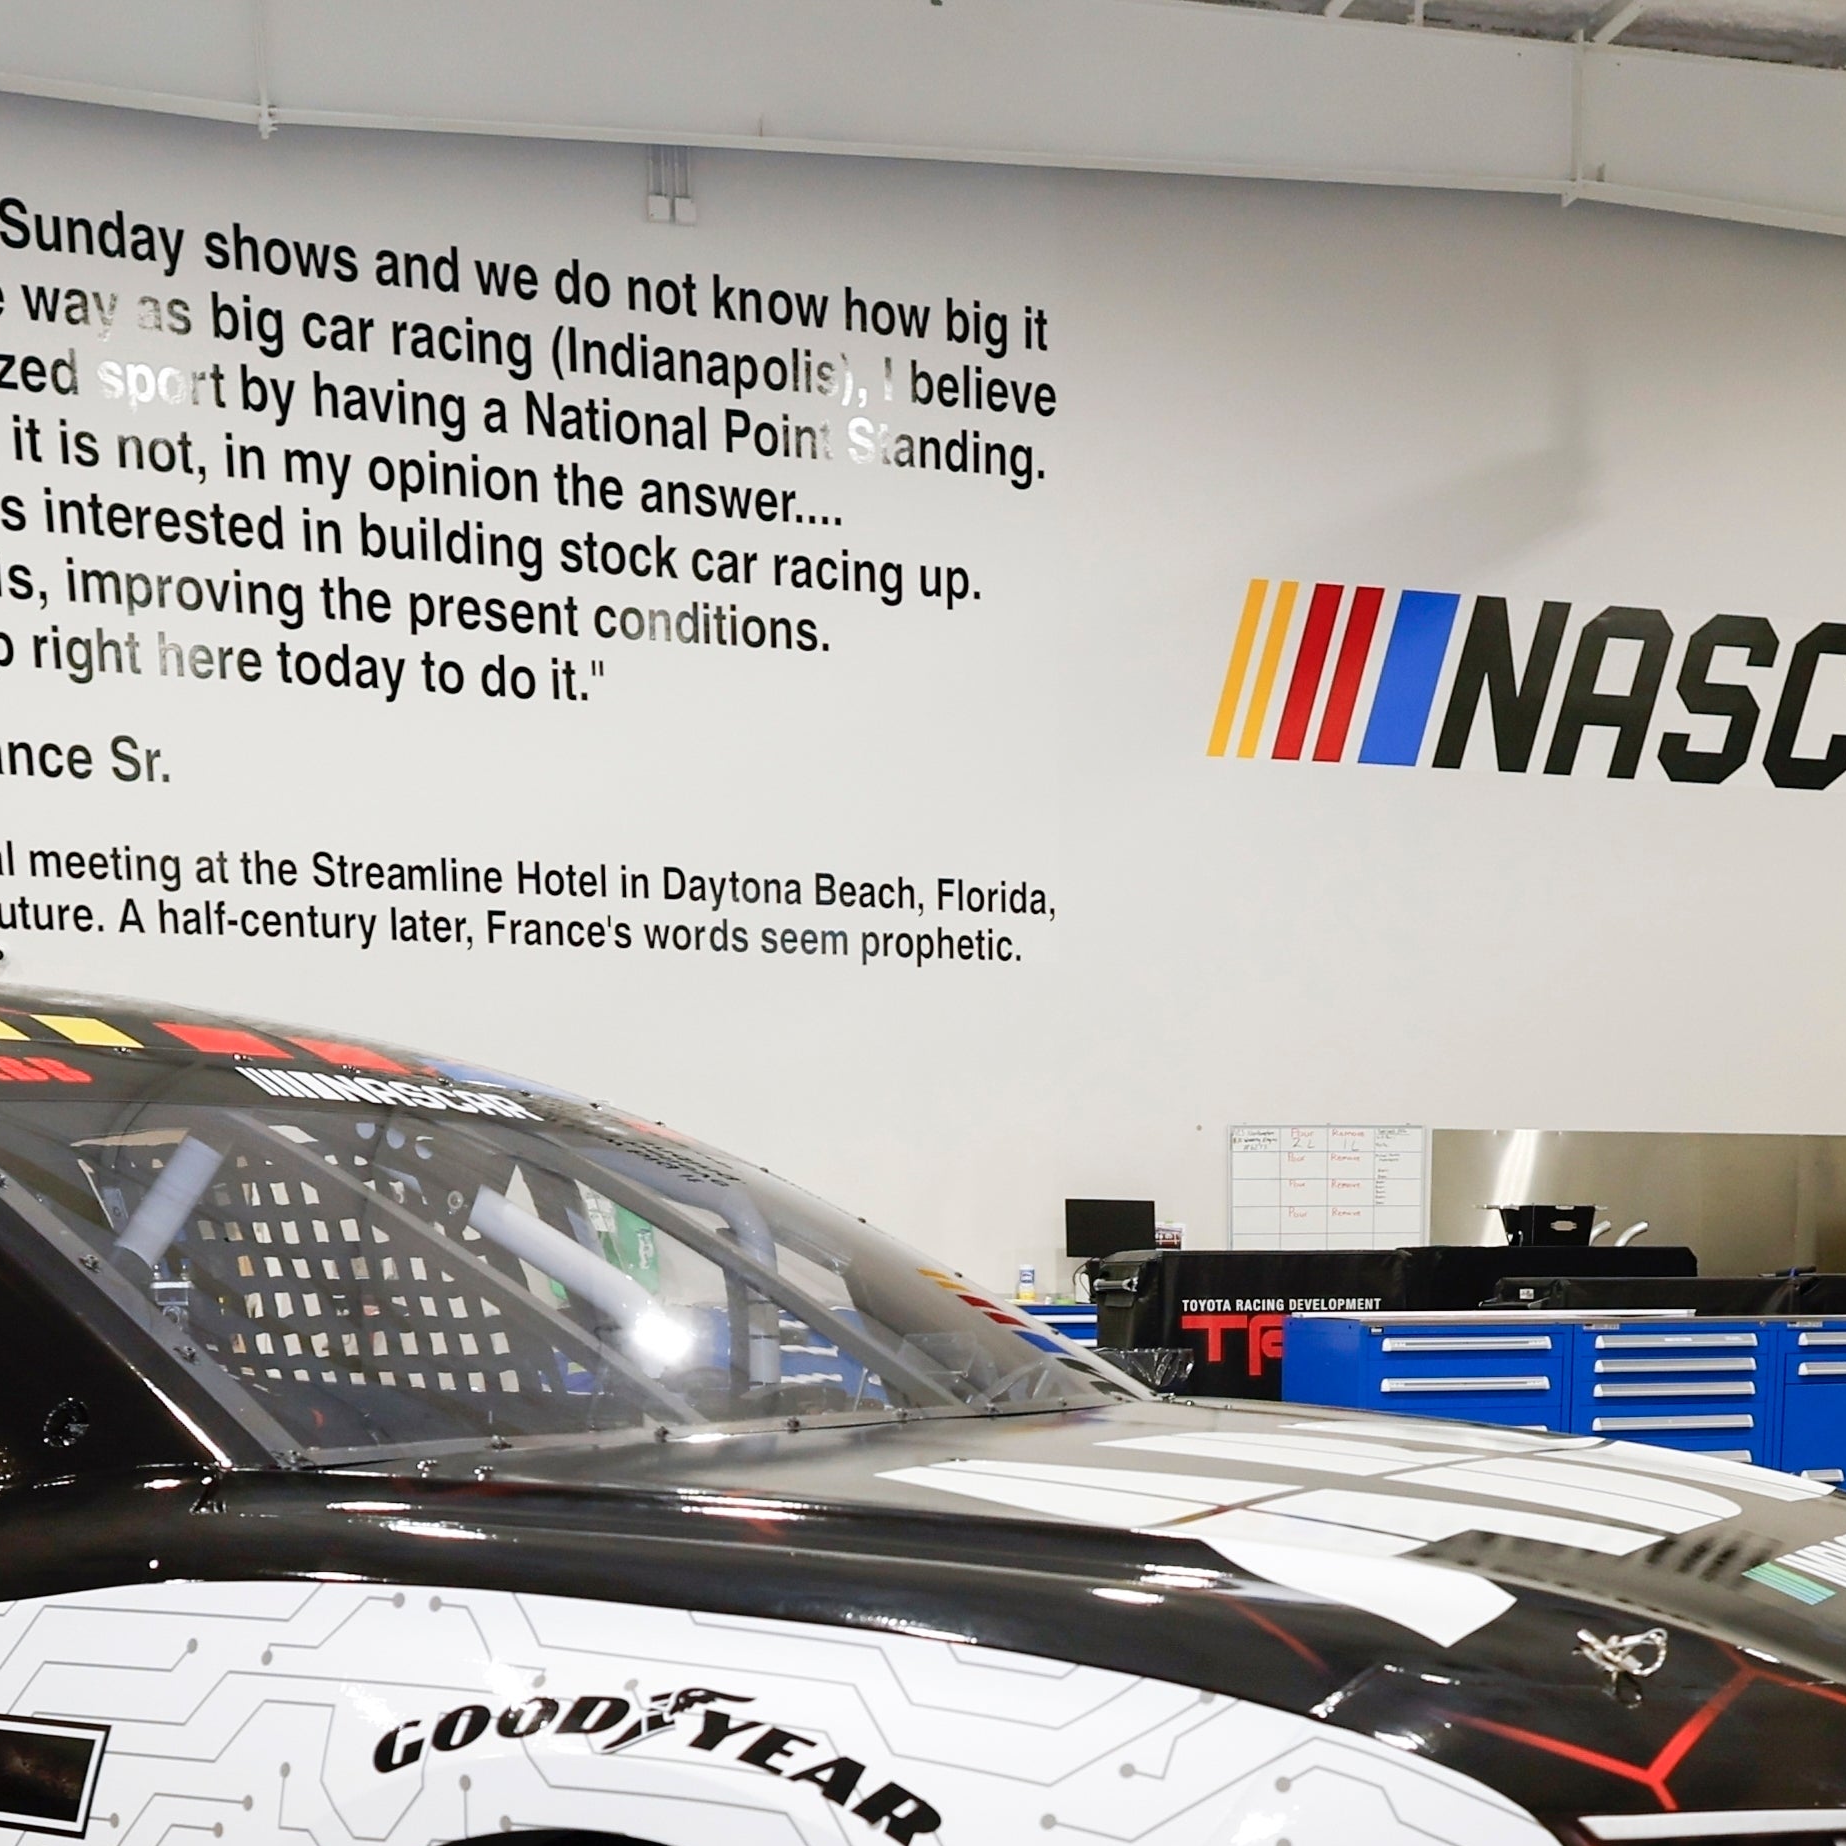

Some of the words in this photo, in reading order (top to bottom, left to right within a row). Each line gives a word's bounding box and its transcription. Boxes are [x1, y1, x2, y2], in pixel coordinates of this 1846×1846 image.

[204, 221, 359, 283] shows
[374, 245, 460, 294] and
[473, 259, 539, 301] we
[554, 258, 612, 309] do
[627, 272, 698, 318] not
[712, 272, 830, 329] know
[844, 285, 931, 339] how
[945, 296, 1008, 360] big
[1024, 304, 1049, 352] it
[210, 290, 285, 359] big
[301, 311, 375, 353] car
[391, 315, 533, 382] racing
[910, 358, 1057, 418] believe
[239, 362, 296, 428] by
[312, 369, 467, 443] having
[483, 397, 509, 434] a
[524, 389, 708, 452] National
[11, 413, 44, 464] it
[58, 417, 100, 468] is
[117, 430, 207, 486] not,
[224, 431, 266, 481] in
[283, 448, 353, 501] my
[367, 449, 539, 504] opinion
[552, 461, 624, 511] the
[42, 486, 285, 551] interested
[301, 506, 343, 555] in
[359, 511, 543, 583] building
[559, 531, 679, 580] stock
[691, 547, 759, 585] car
[773, 548, 904, 607] racing
[919, 564, 981, 611] up.
[65, 556, 305, 631] improving
[318, 575, 392, 624] the
[408, 591, 580, 638] present
[593, 600, 830, 653] conditions.
[275, 641, 407, 703] today
[420, 650, 465, 695] to
[480, 653, 537, 700] do
[110, 734, 171, 783] Sr.
[28, 844, 182, 893] meeting
[195, 850, 230, 885] at
[239, 849, 298, 887] the
[312, 850, 504, 895] Streamline
[516, 860, 608, 898] Hotel
[620, 864, 650, 900] in
[662, 865, 803, 912] Daytona
[814, 872, 924, 918] Beach,
[936, 877, 1056, 923] Florida,
[118, 897, 146, 934] A
[157, 898, 378, 951] half-century
[389, 905, 474, 951] later,
[486, 909, 633, 950] France's
[642, 917, 749, 953] words
[760, 927, 849, 956] seem
[861, 925, 1022, 969] prophetic.
[311, 1072, 545, 1122] NASCAR
[1182, 1299, 1231, 1312] TOYOTA
[1236, 1298, 1285, 1312] RACING
[1289, 1297, 1382, 1311] DEVELOPMENT
